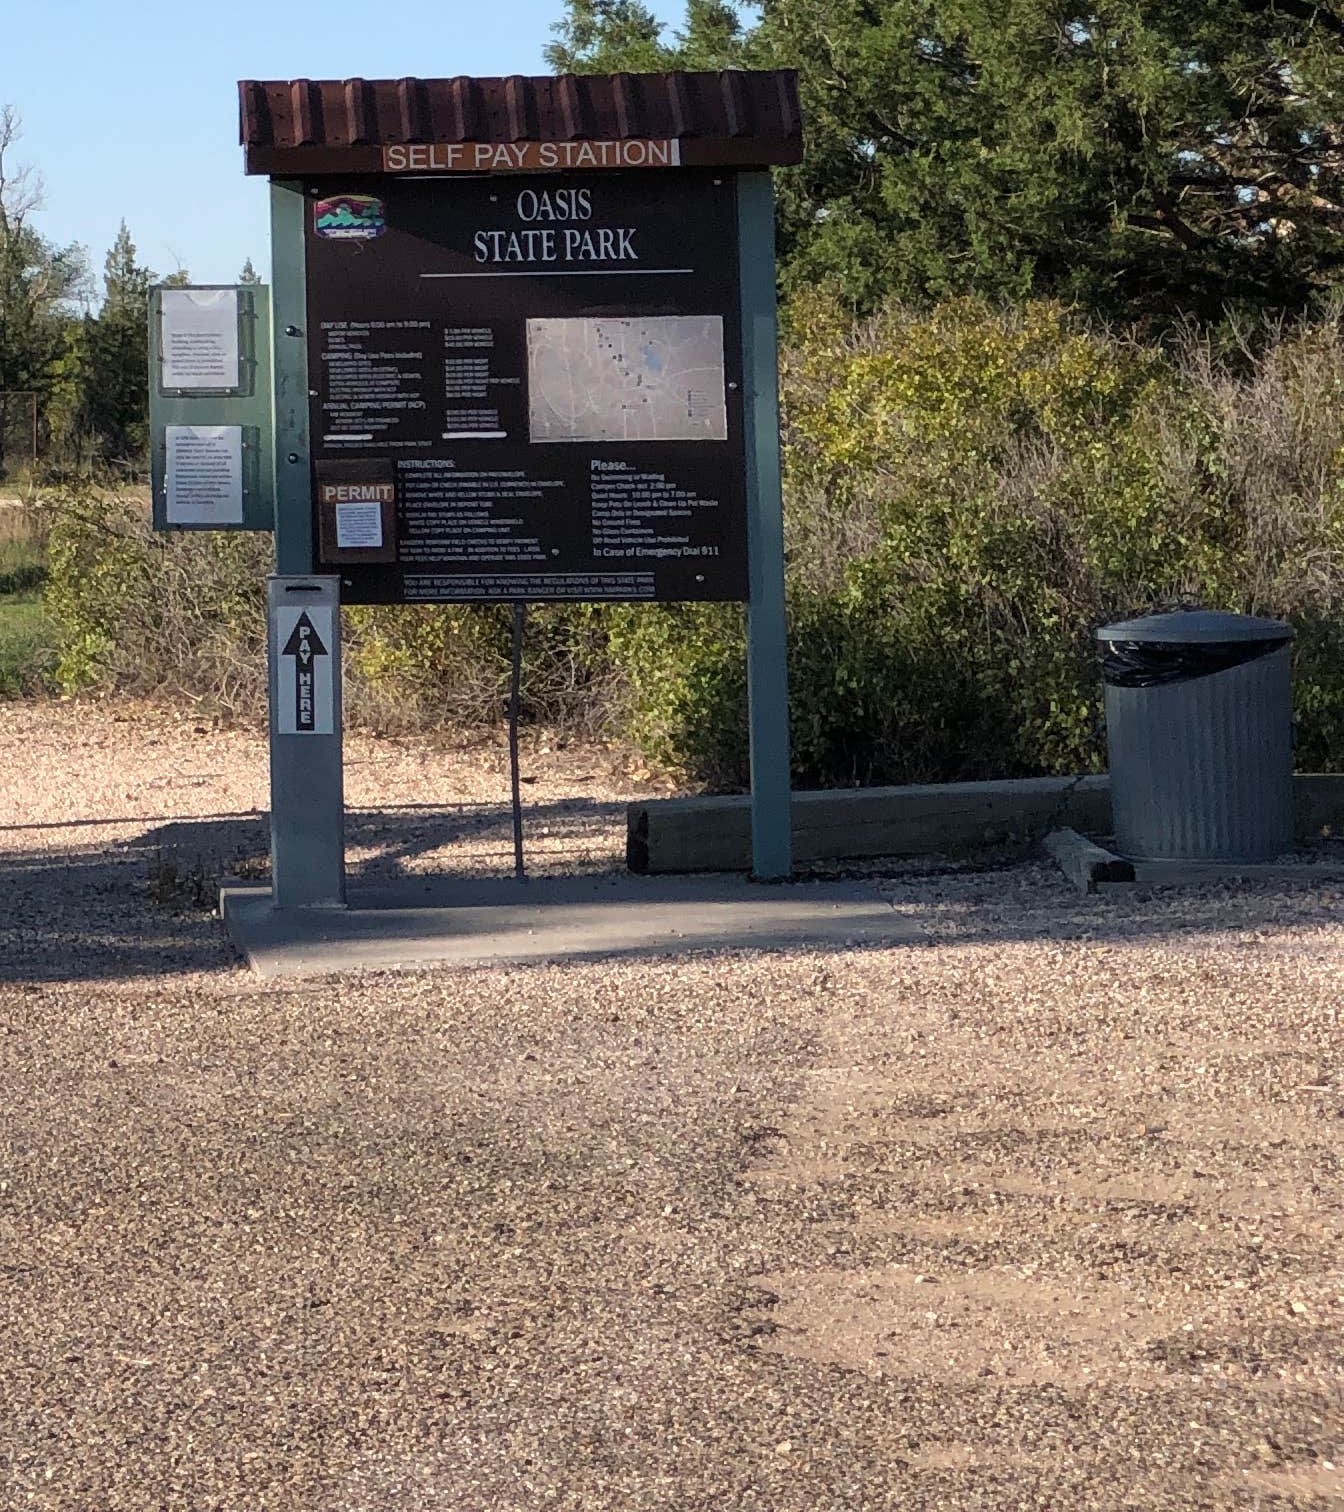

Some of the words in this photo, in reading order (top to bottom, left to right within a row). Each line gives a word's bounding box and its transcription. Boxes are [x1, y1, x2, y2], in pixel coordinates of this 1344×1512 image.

[387, 144, 464, 170] SELF
[475, 143, 530, 168] PAY
[539, 140, 669, 167] STATION
[517, 188, 592, 222] OASIS
[474, 230, 557, 263] STATE
[565, 228, 640, 261] PARK
[325, 485, 392, 501] PERMIT
[593, 548, 602, 557] In
[603, 548, 625, 557] Case
[626, 548, 634, 557] of
[635, 548, 682, 557] Emergency
[683, 547, 700, 556] Dial
[298, 626, 312, 665] PAY
[299, 672, 312, 724] HERE
